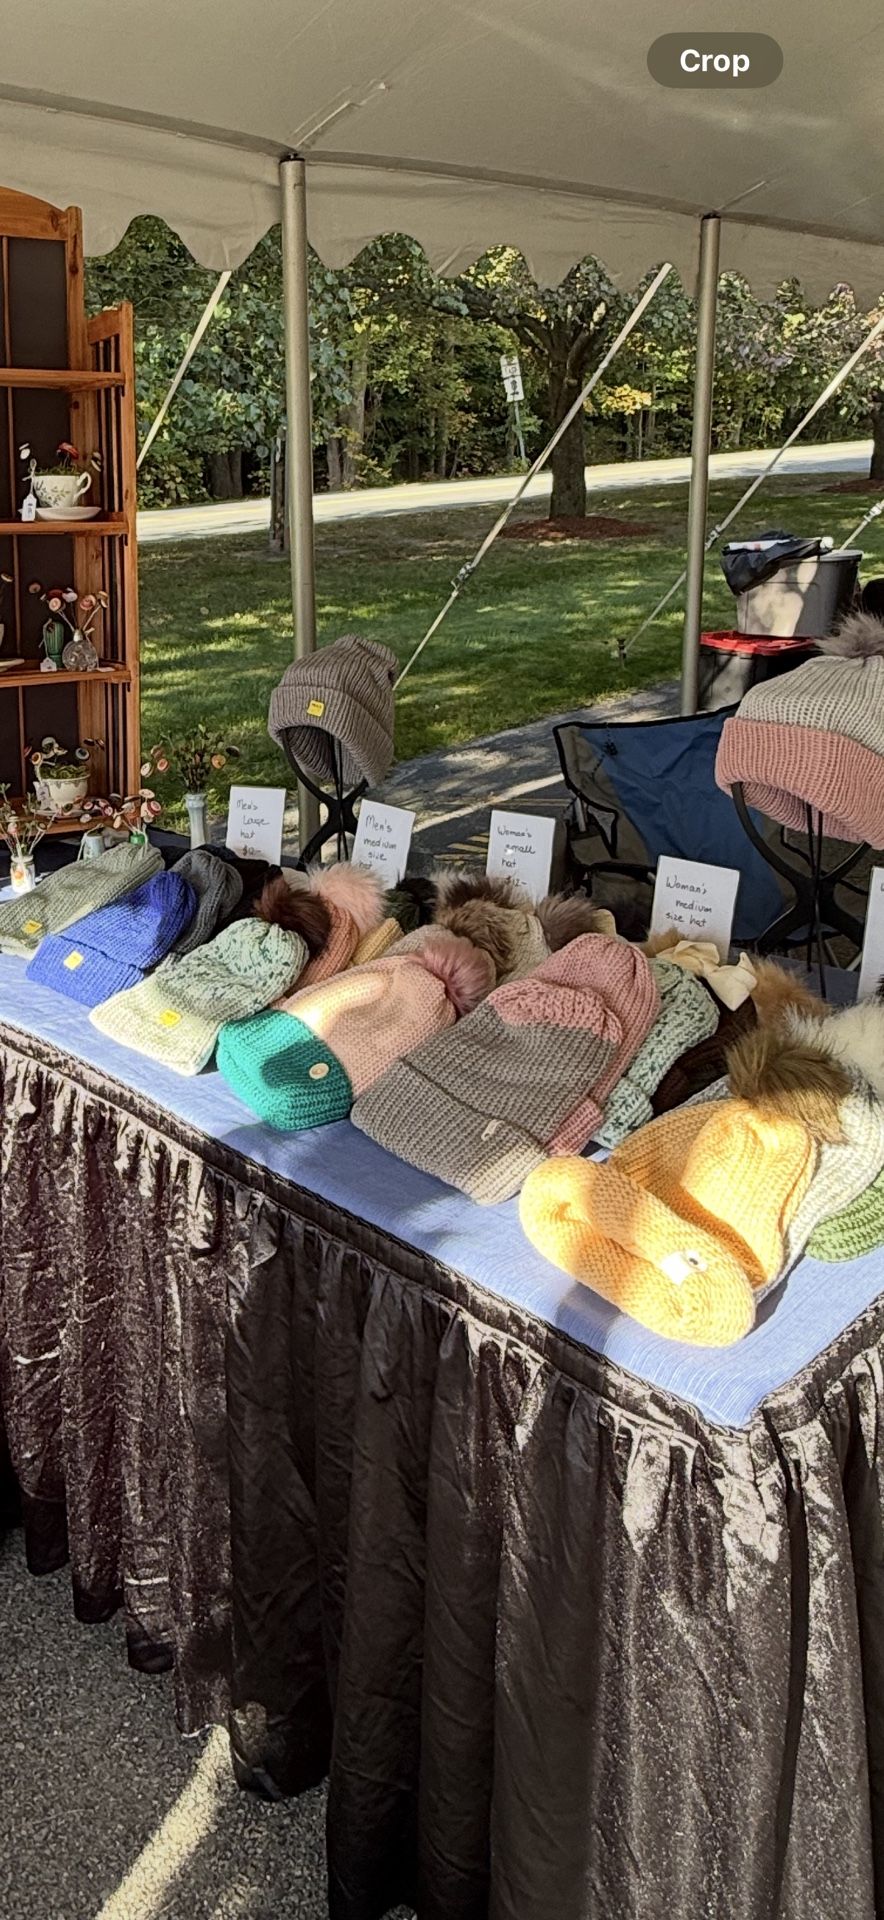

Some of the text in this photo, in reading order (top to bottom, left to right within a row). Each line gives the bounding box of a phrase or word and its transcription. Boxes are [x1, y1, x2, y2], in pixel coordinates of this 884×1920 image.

[236, 799, 258, 810] Men's
[365, 814, 392, 832] Men's
[240, 829, 255, 839] hat
[363, 837, 397, 849] medium
[504, 844, 536, 854] small
[501, 858, 516, 868] hat
[666, 875, 707, 894] Woman's
[676, 899, 712, 912] medium
[665, 912, 707, 927] size hat
